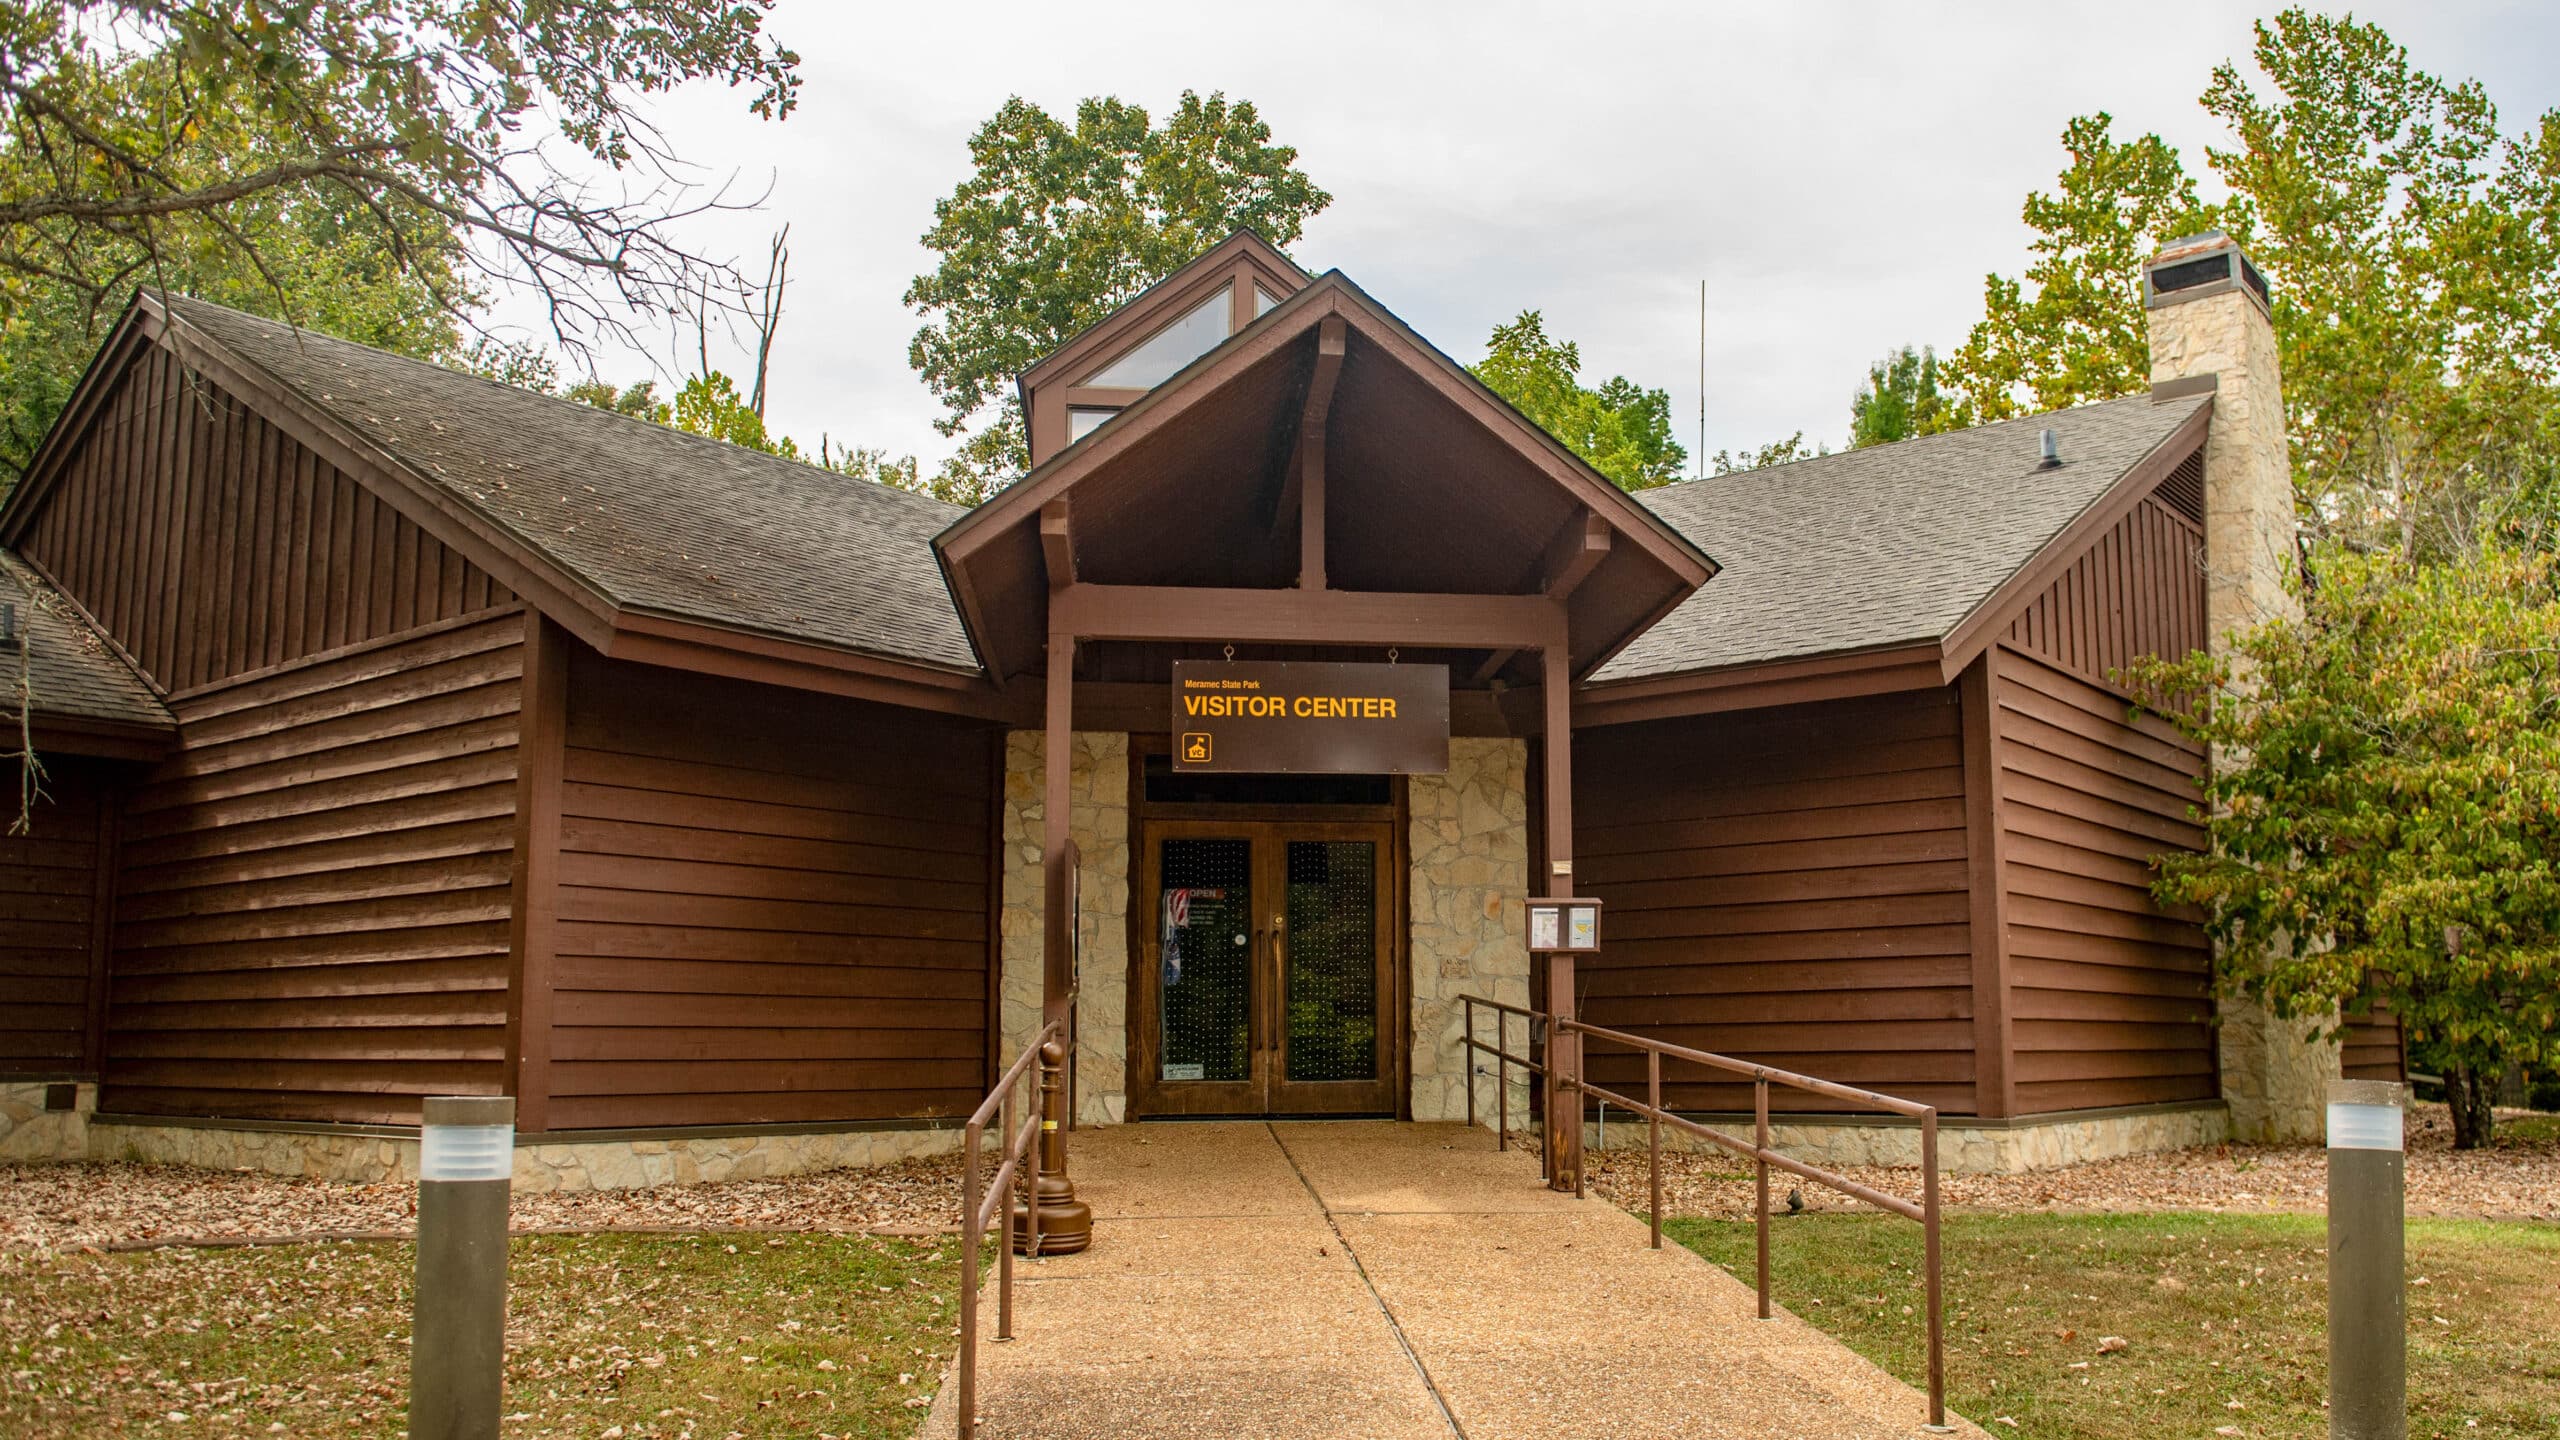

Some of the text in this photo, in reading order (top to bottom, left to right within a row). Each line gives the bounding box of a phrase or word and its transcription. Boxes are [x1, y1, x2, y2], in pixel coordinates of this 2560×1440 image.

[1185, 679, 1261, 689] Meramec State Park
[1183, 695, 1397, 718] VISITOR CENTER
[1188, 889, 1217, 897] OPEN
